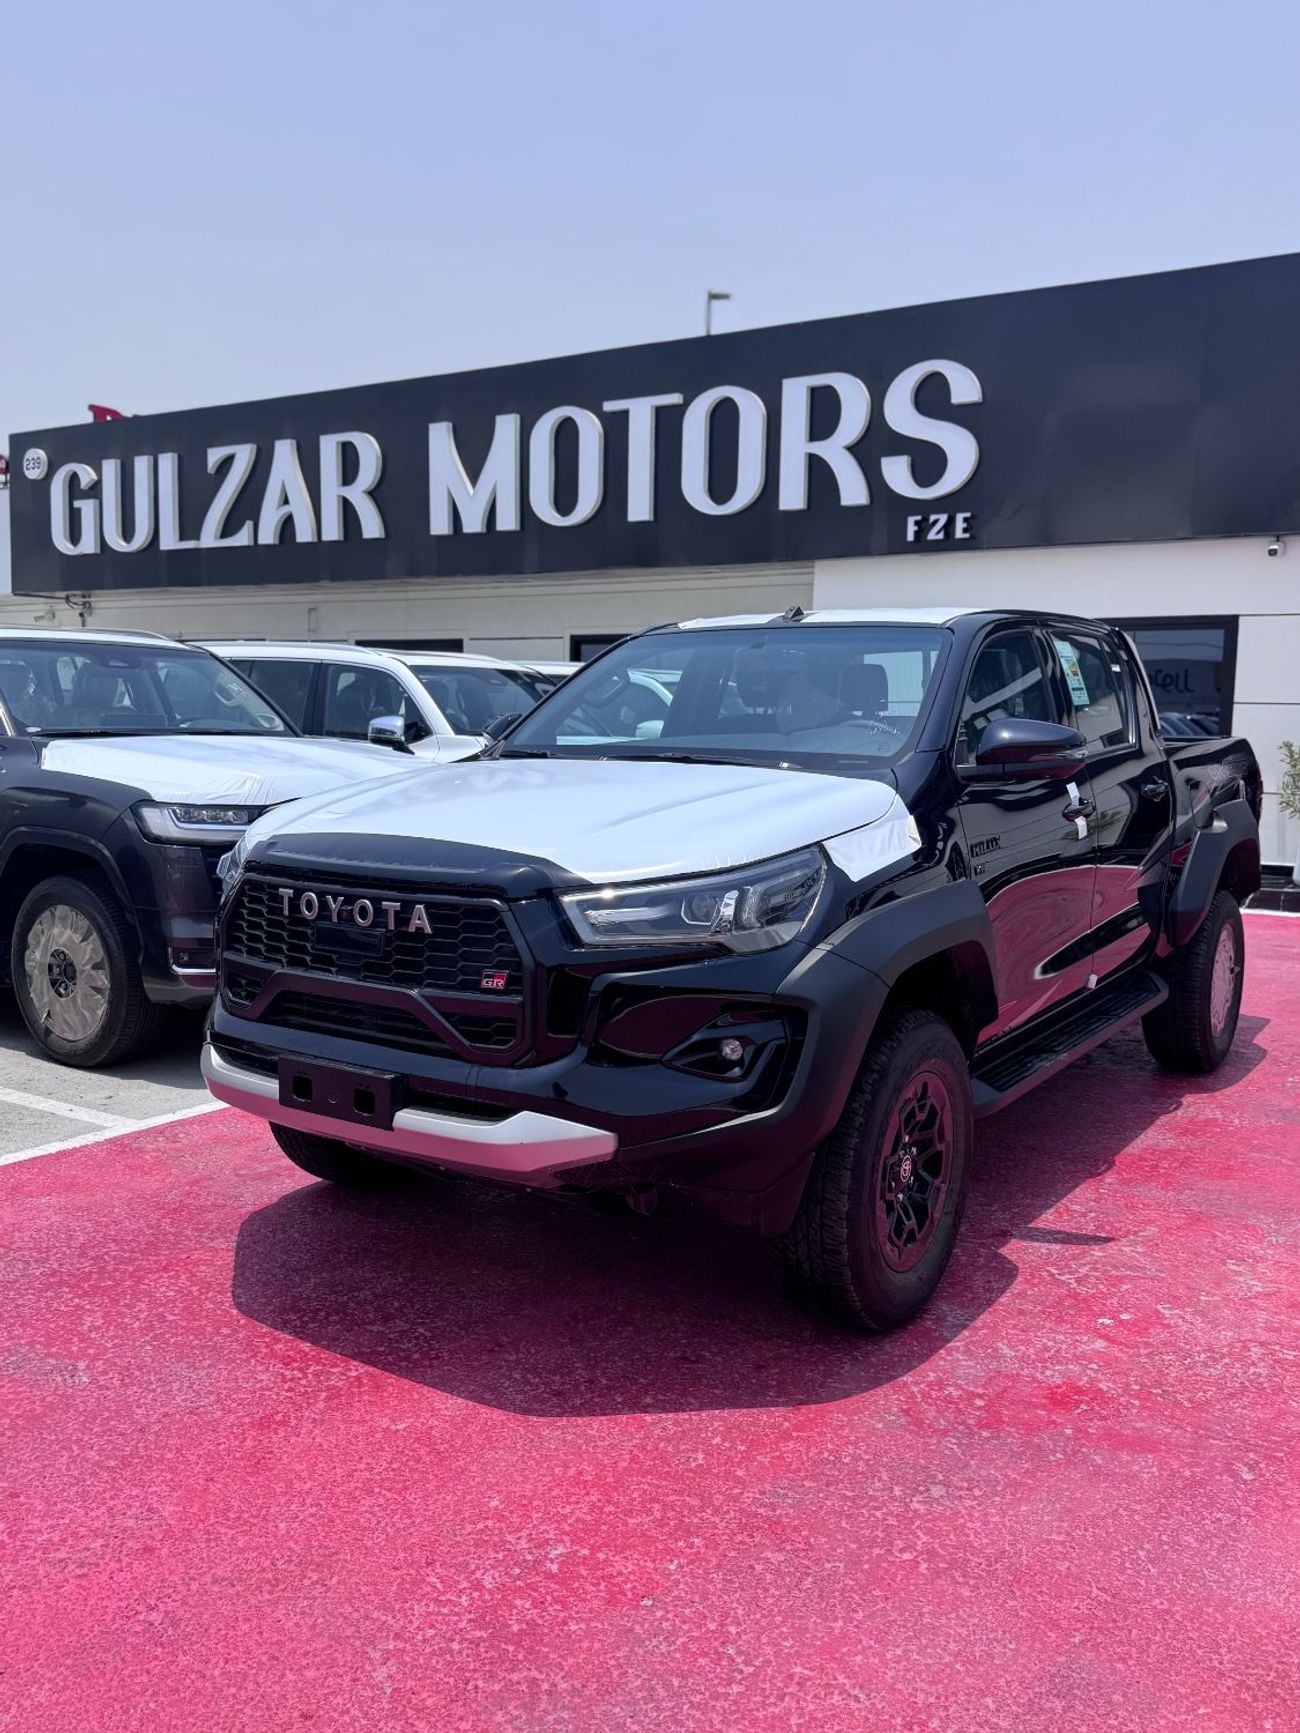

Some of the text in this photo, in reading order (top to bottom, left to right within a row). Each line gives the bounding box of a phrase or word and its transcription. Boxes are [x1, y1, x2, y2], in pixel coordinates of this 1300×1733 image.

[25, 457, 41, 471] 239
[51, 359, 983, 556] GULZAR MOTORS
[906, 512, 972, 542] FZE
[278, 887, 433, 934] TOYOTA
[482, 978, 505, 989] GR
